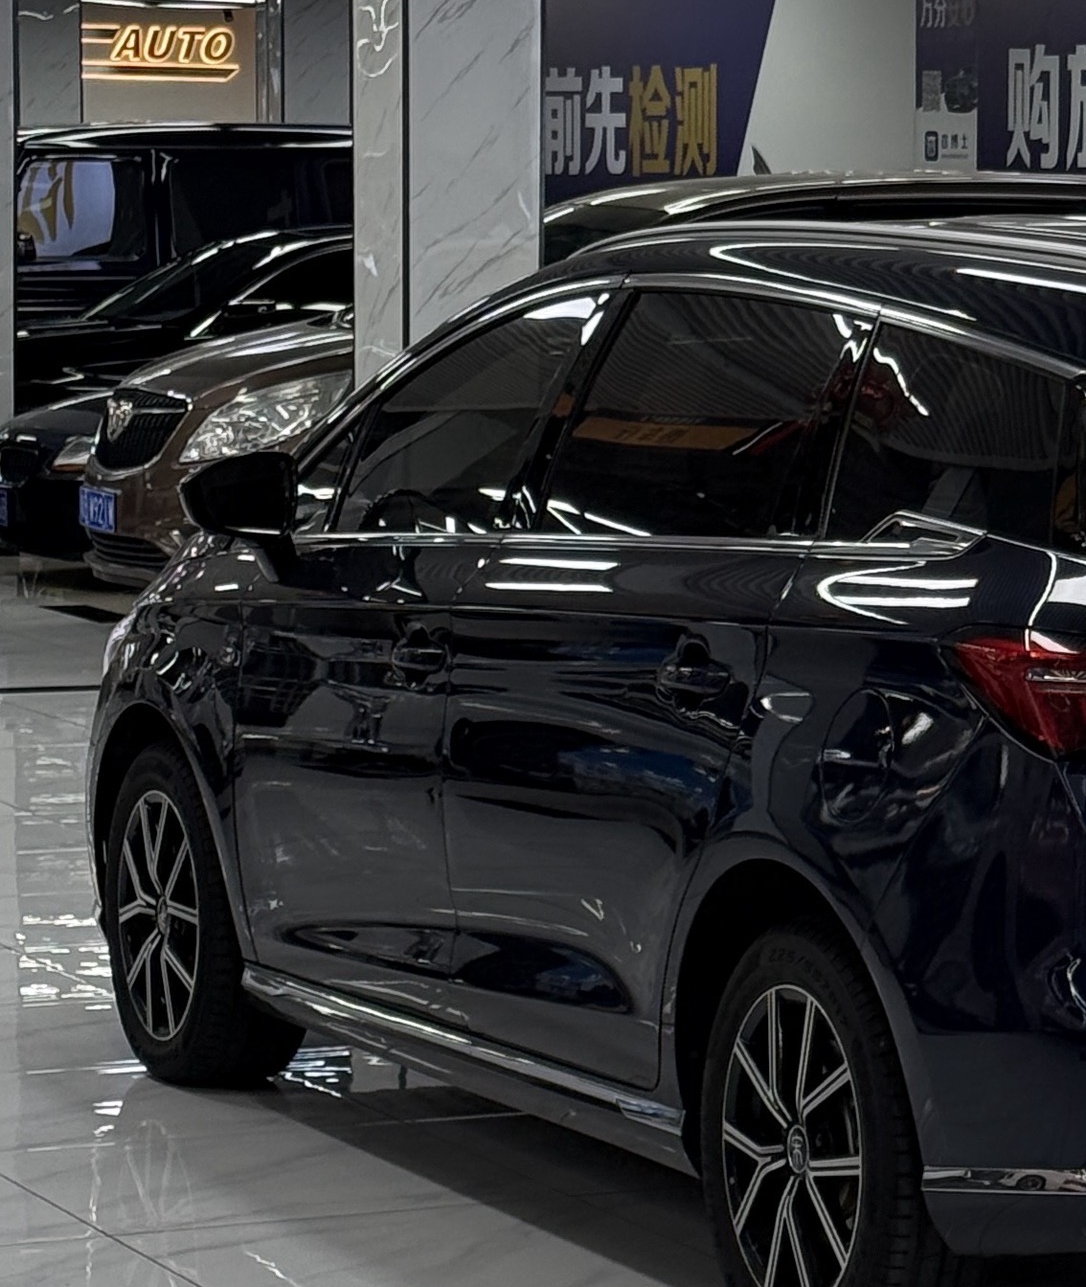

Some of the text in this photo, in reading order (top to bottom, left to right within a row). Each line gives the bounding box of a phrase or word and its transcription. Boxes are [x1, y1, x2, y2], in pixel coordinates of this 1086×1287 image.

[110, 24, 236, 65] AUTO
[544, 63, 718, 177] 前先检测
